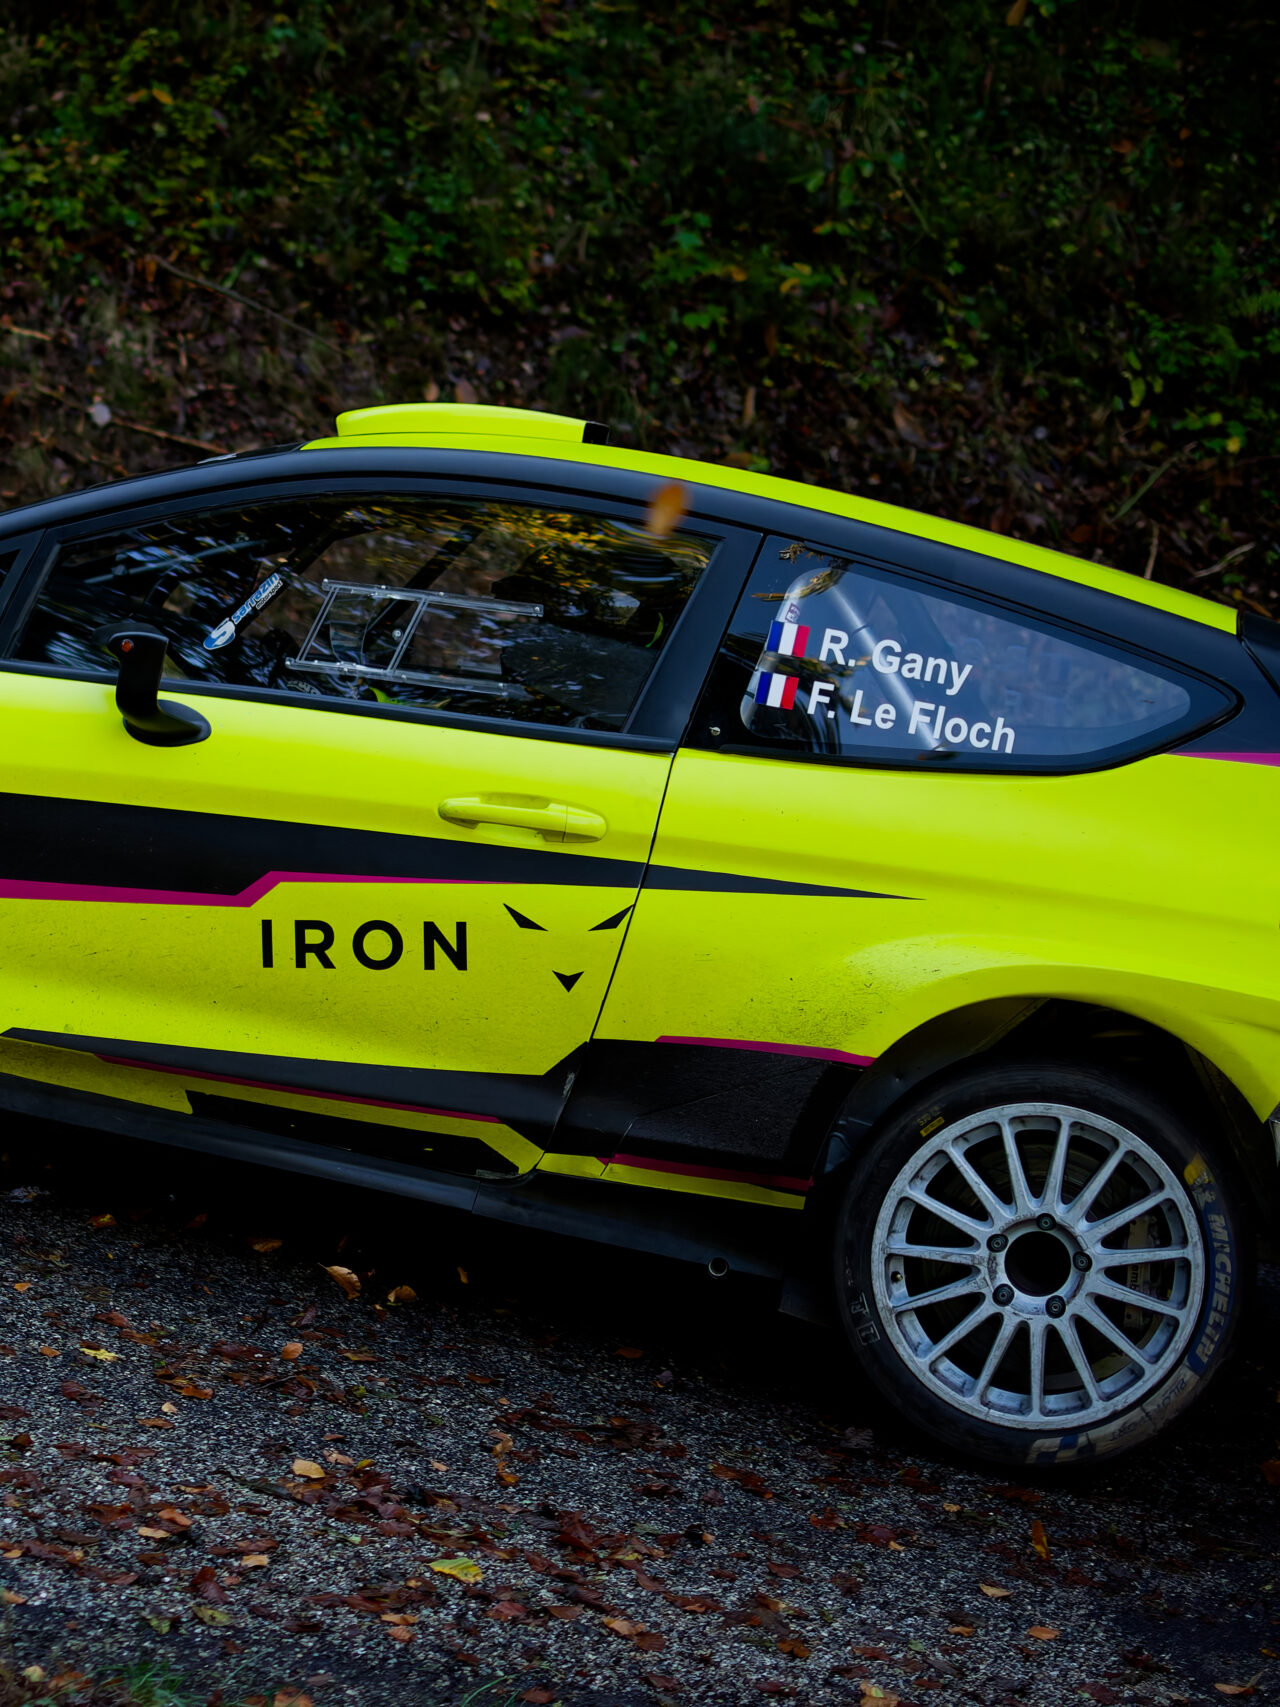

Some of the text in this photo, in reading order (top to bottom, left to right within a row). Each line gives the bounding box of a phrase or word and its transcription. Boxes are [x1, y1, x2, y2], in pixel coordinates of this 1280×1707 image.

[232, 572, 279, 624] sarrazin
[818, 627, 973, 696] R. Gany
[807, 680, 1016, 754] F. Le Floch
[261, 919, 468, 971] IRON
[1194, 1213, 1233, 1364] MICHELIN
